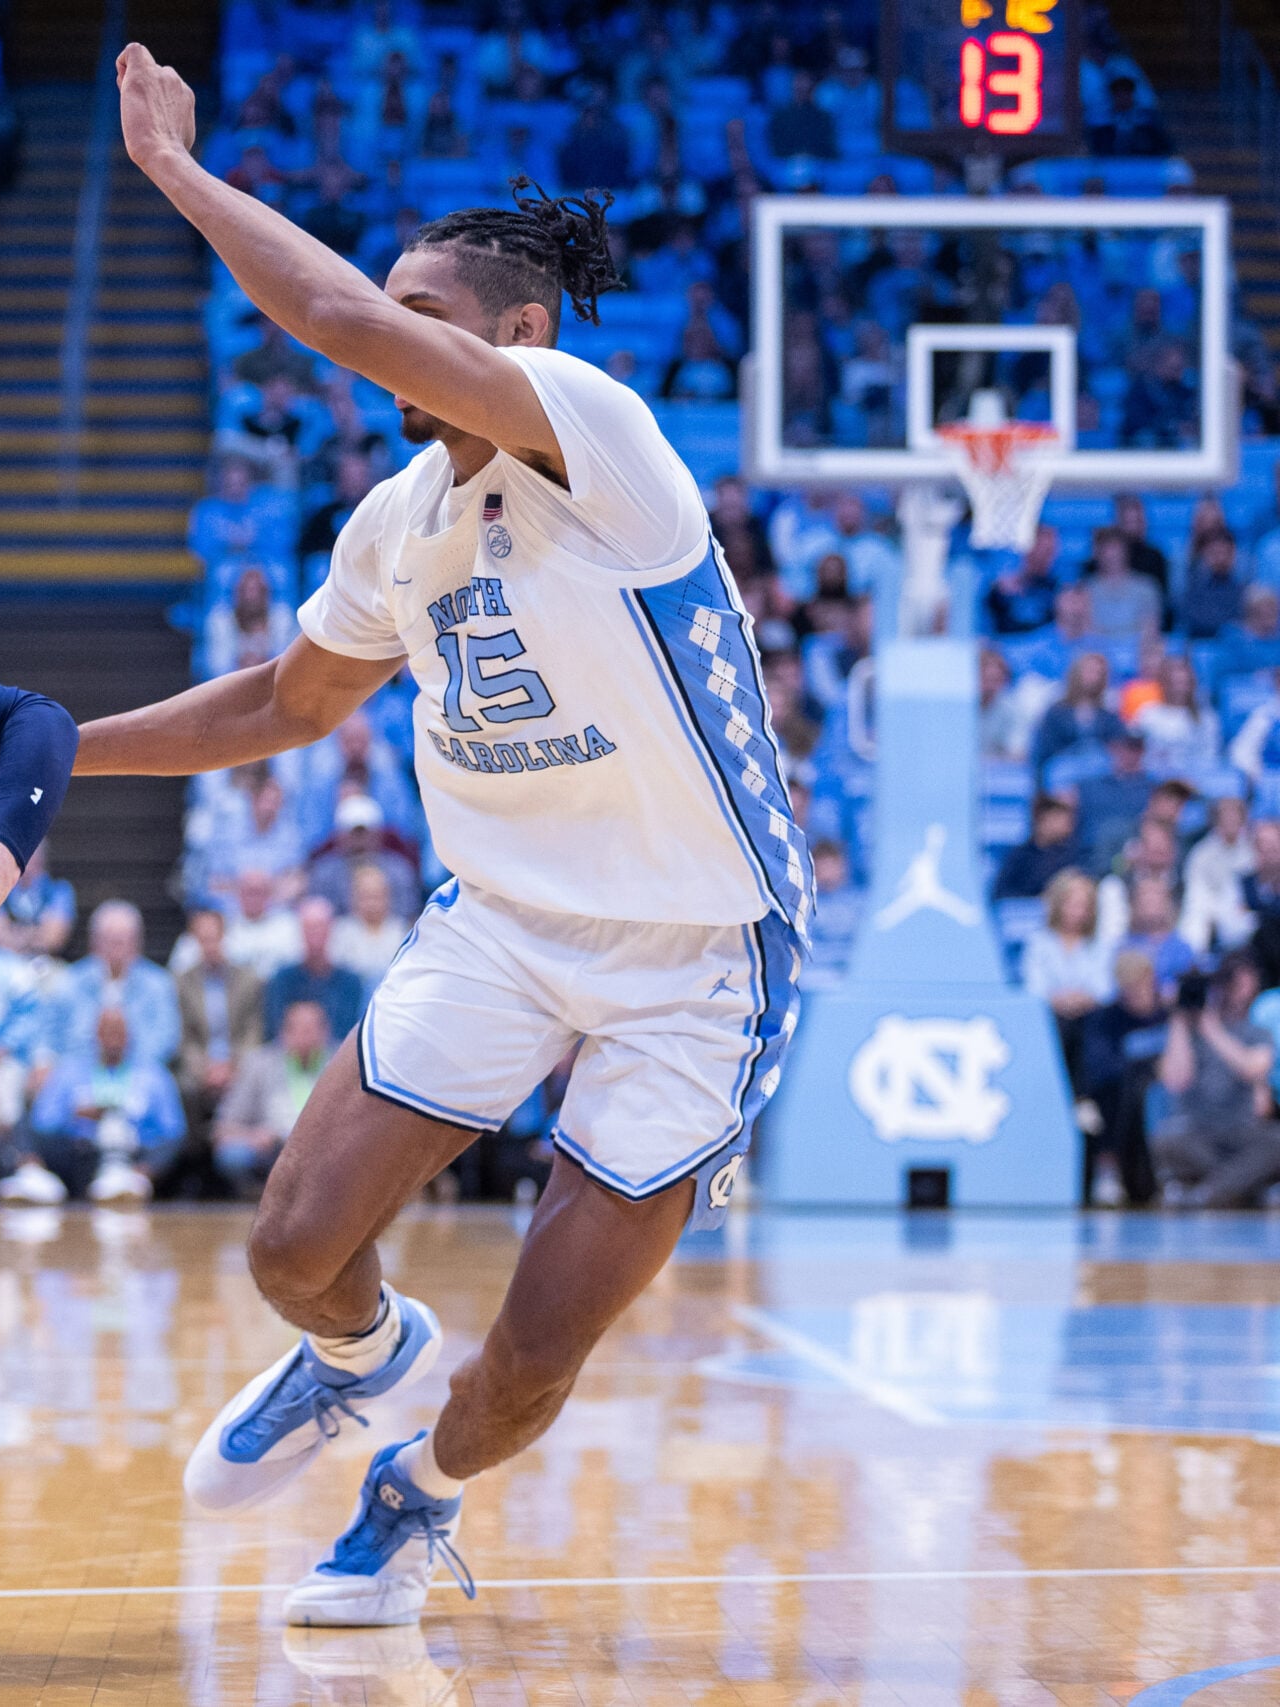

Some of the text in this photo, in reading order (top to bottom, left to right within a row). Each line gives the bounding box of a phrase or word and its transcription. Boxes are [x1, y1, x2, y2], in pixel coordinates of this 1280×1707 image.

[960, 32, 1043, 134] 13
[427, 577, 512, 634] NOTH
[435, 629, 556, 732] 15
[429, 725, 617, 774] CAROLINA
